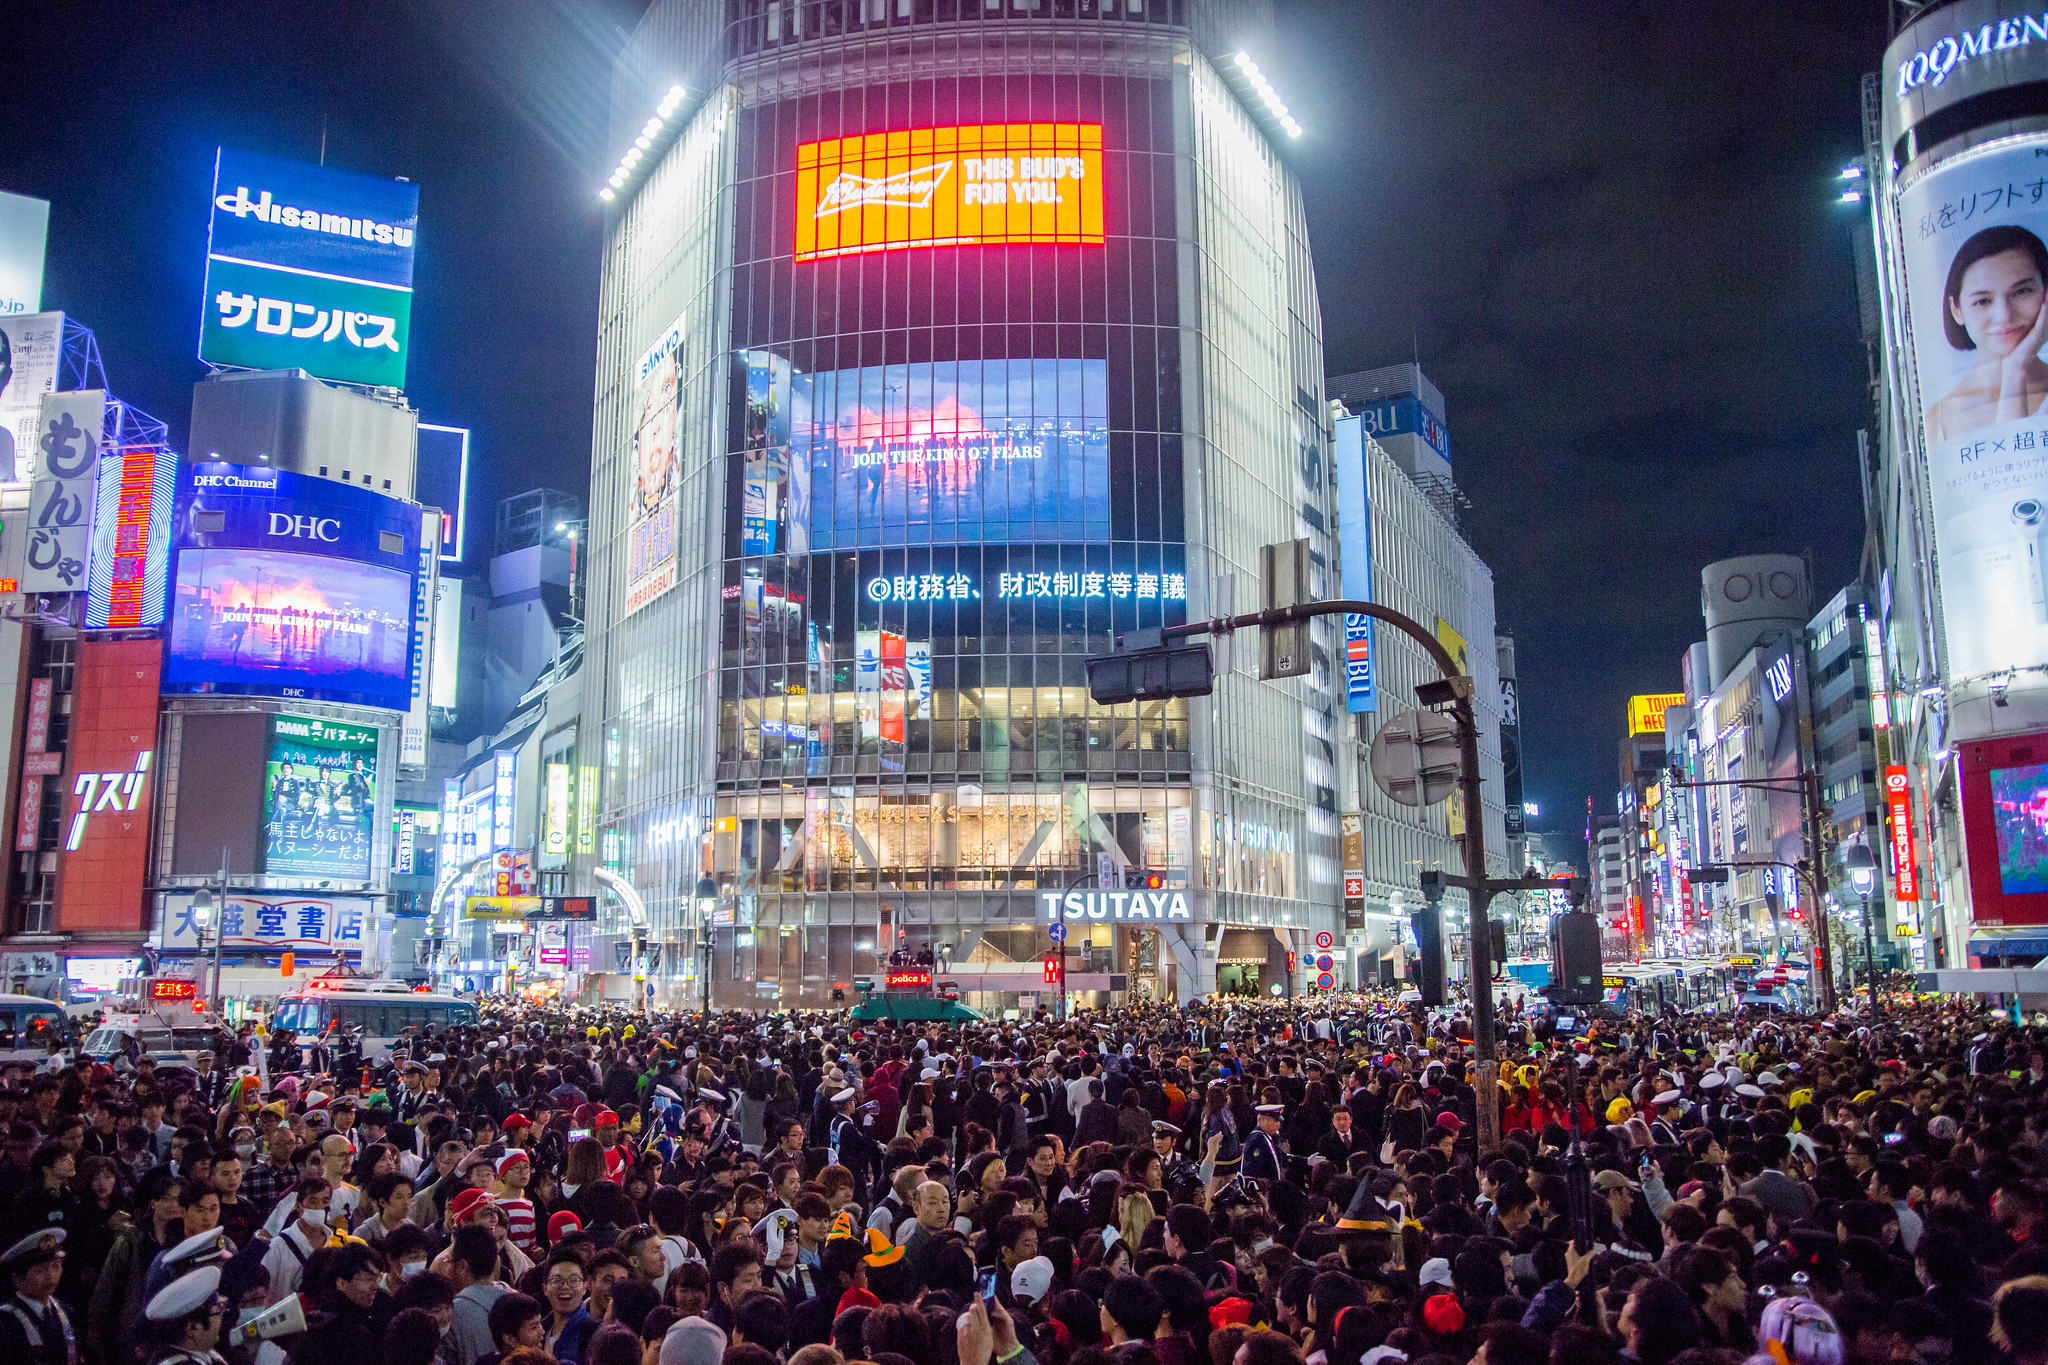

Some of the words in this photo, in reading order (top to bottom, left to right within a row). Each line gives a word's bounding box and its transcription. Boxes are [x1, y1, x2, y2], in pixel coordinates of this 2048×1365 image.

[963, 157, 1014, 181] THIS
[1019, 156, 1085, 181] BUD'S
[963, 182, 1008, 205] FOR
[1010, 181, 1063, 204] YOU.
[215, 187, 413, 248] Hisamitsu
[215, 291, 400, 352] サロンパス
[852, 450, 886, 469] JOIN
[889, 449, 924, 464] THE
[925, 446, 964, 463] KING
[968, 445, 990, 460] OF
[991, 445, 1043, 460] FEARS
[194, 475, 222, 487] DHC
[224, 475, 277, 489] Channel
[267, 512, 341, 542] DHC
[1000, 571, 1187, 599] 財政制度等審議
[221, 611, 250, 624] JOIN
[252, 613, 279, 626] THE
[280, 615, 314, 629] KING
[315, 618, 333, 630] OF
[333, 619, 370, 635] FEARS
[410, 630, 425, 699] neon
[1345, 612, 1370, 697] SEIBU
[283, 687, 305, 697] DHC
[276, 720, 309, 737] DMM
[323, 728, 375, 744] バヌーシー
[404, 736, 423, 744] 3719
[405, 727, 422, 736] (03)
[403, 743, 422, 751] 2468
[65, 750, 152, 851] クスリ
[1663, 767, 1676, 821] KARAOKE
[267, 840, 369, 861] バヌーシーだよ!
[1349, 880, 1361, 895] 本
[1043, 892, 1190, 919] TSUTAYA
[174, 905, 363, 940] 大盛堂書店
[892, 974, 918, 984] police
